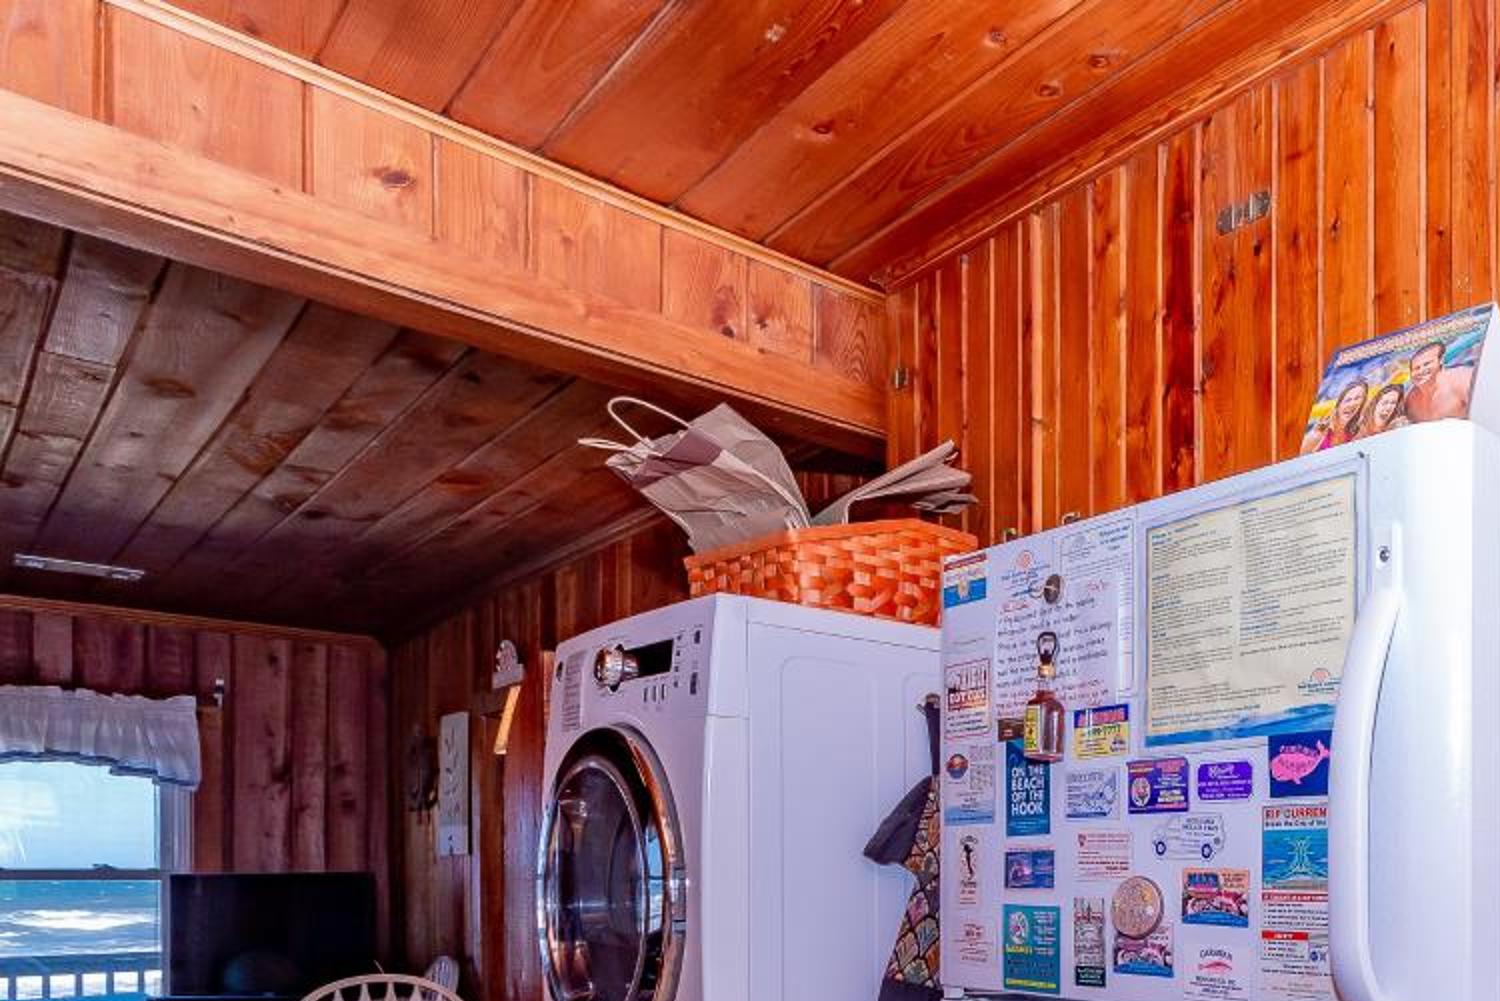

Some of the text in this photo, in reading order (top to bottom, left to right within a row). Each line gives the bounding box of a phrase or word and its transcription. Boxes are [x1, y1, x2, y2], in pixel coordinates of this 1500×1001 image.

[1011, 763, 1044, 777] ON THE
[1011, 776, 1045, 791] BEACH
[1011, 789, 1044, 803] OFF THE
[1011, 801, 1044, 816] HOOK
